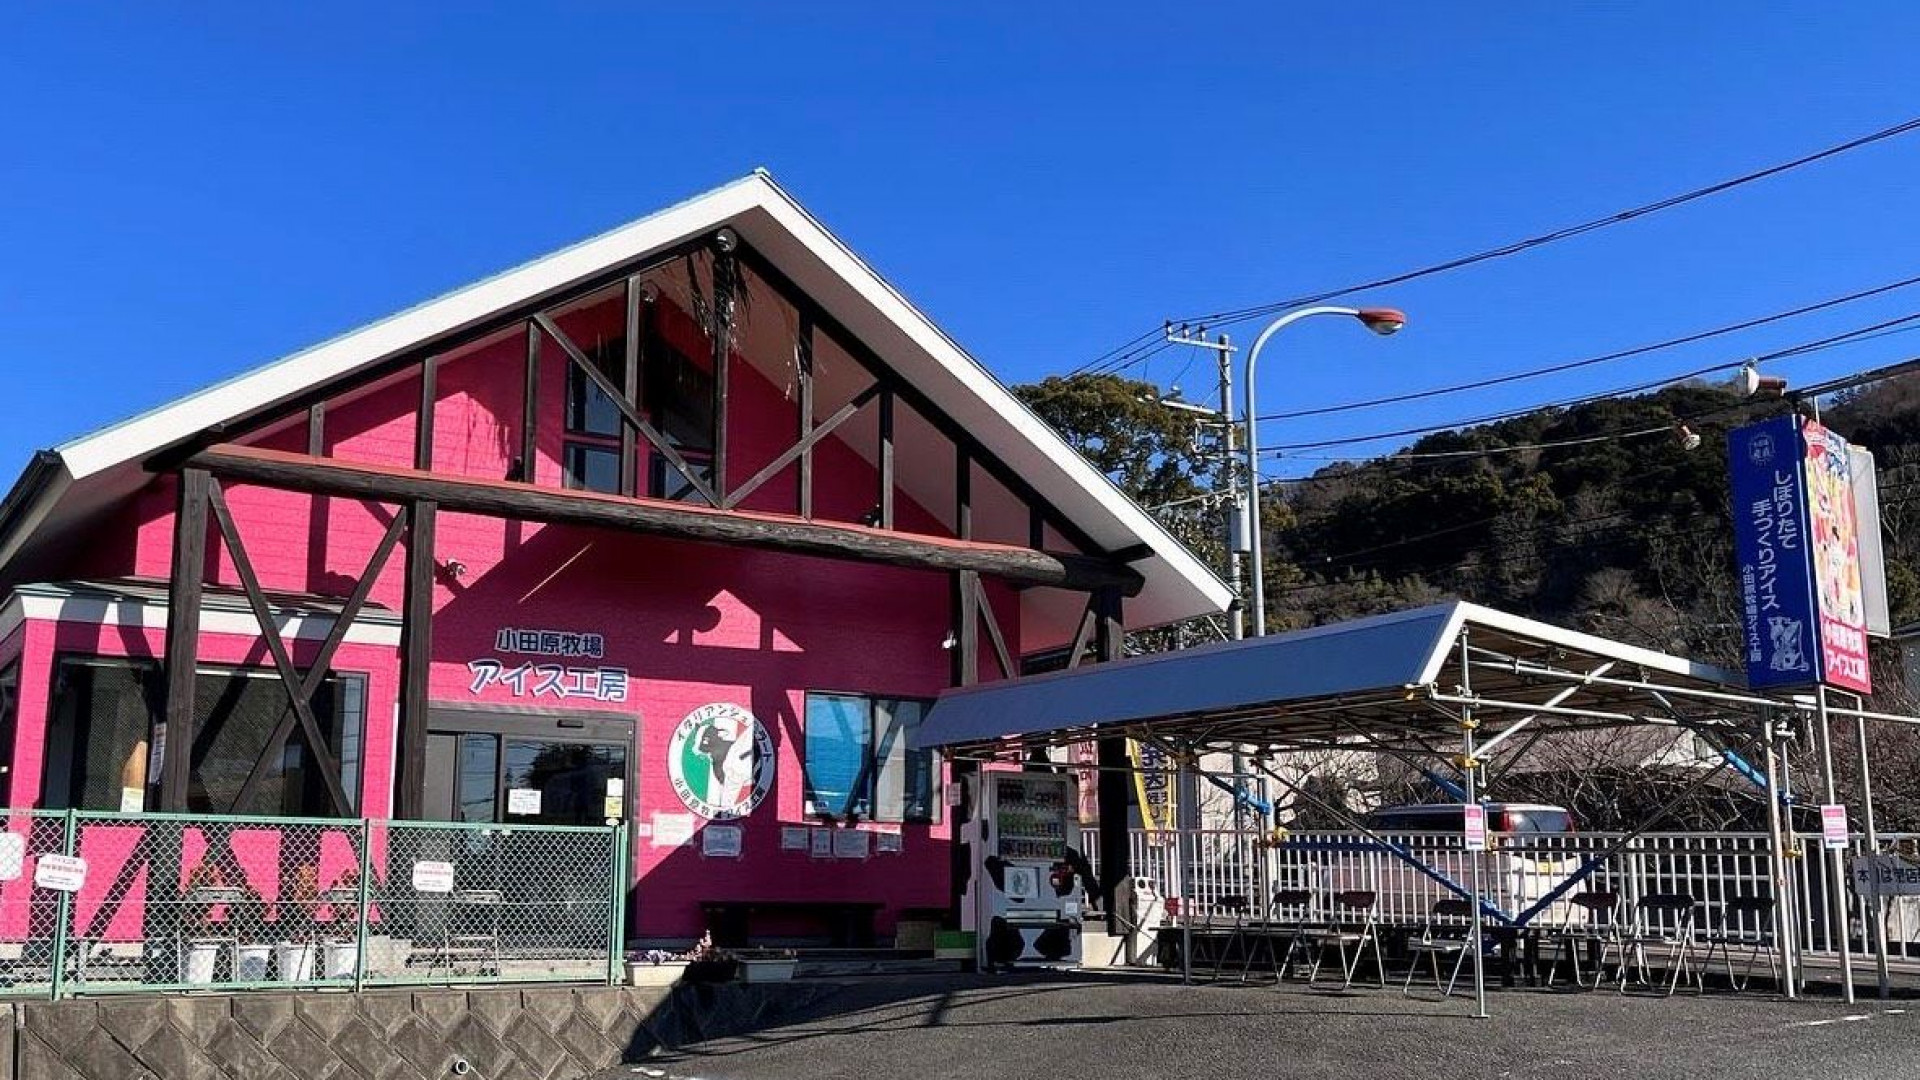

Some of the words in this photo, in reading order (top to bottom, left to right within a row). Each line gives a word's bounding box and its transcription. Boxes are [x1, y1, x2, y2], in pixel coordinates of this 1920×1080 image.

[1773, 470, 1797, 549] しぼりたて
[1752, 498, 1780, 611] 手づくりアイス
[495, 628, 603, 657] 小田原牧場
[468, 659, 629, 702] アイス工房
